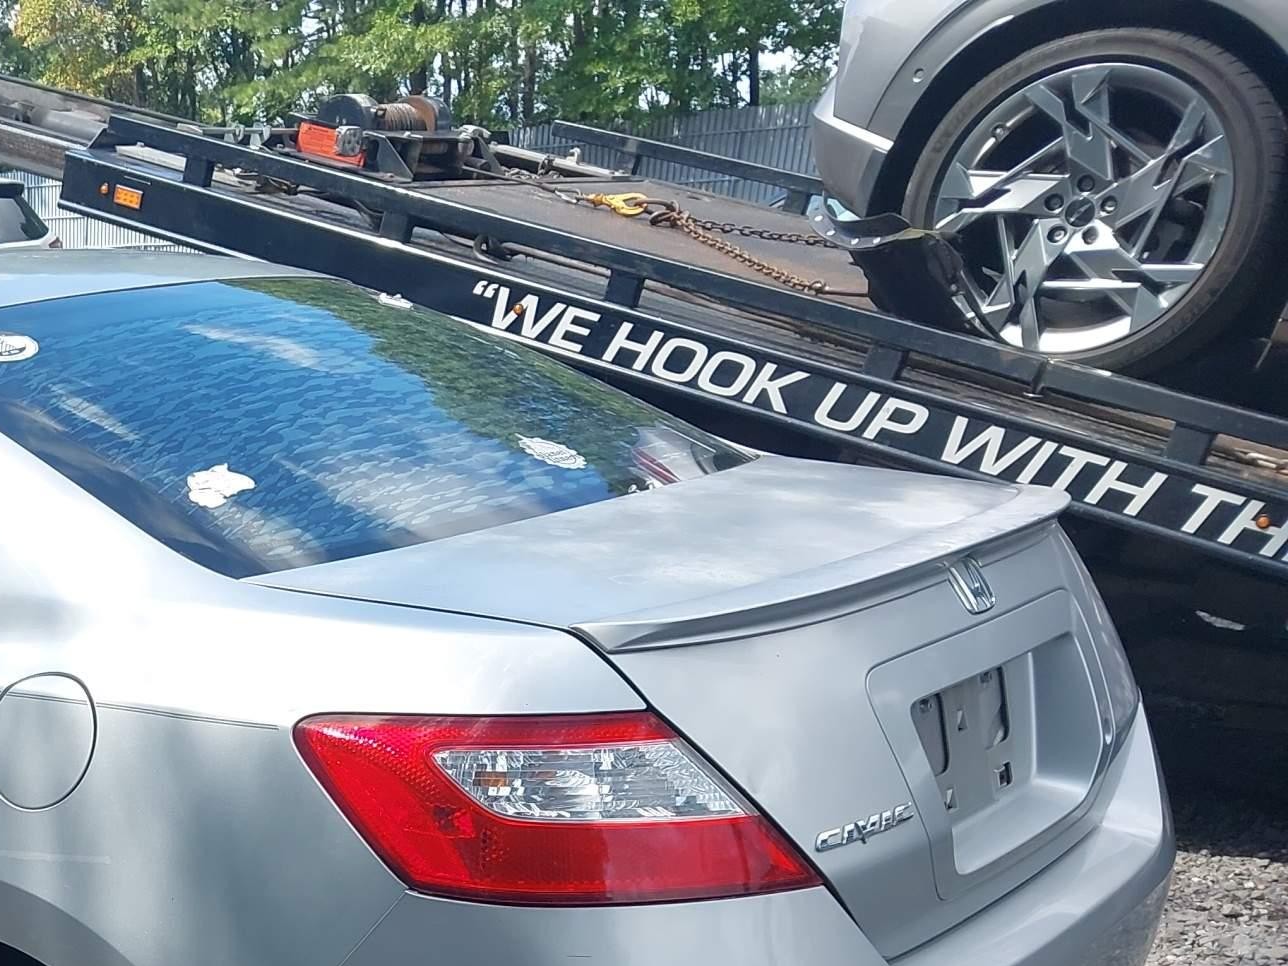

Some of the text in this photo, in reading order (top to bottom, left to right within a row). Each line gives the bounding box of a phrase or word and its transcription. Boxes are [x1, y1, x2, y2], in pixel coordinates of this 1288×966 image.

[601, 322, 811, 414] HOOK
[814, 382, 929, 440] UP
[940, 415, 1169, 517] WITH
[1181, 483, 1288, 561] TH
